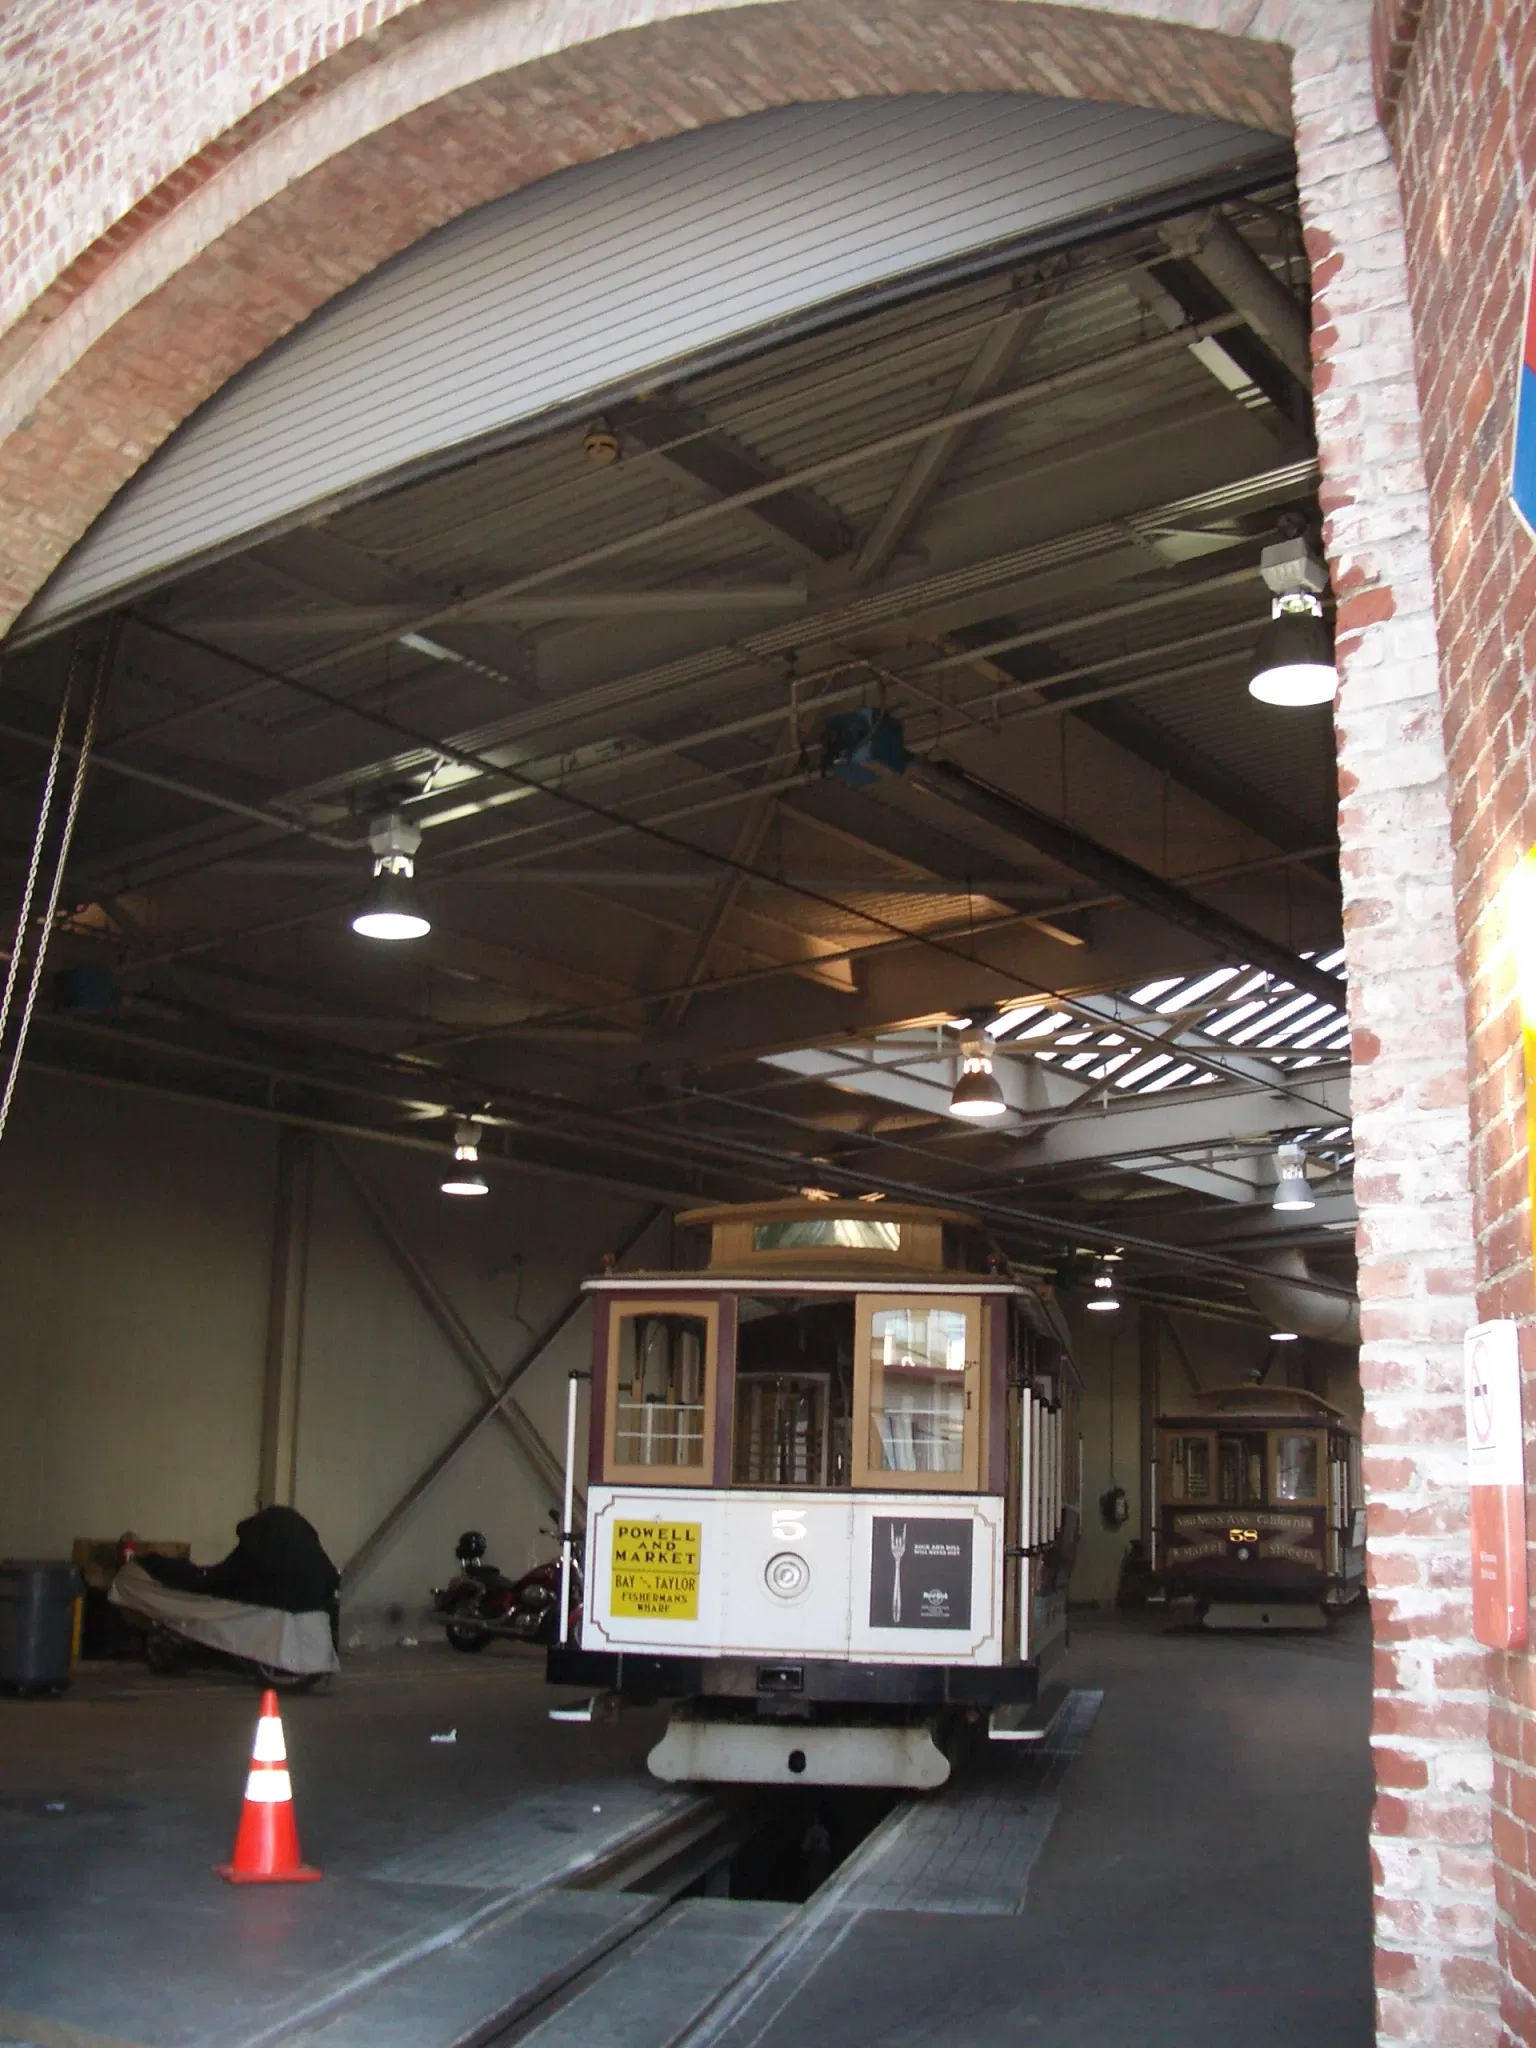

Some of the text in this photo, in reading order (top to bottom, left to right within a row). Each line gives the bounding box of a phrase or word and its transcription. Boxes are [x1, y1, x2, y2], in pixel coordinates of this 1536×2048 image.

[771, 1509, 807, 1541] 5
[1257, 1514, 1313, 1528] California
[618, 1526, 696, 1542] POWELL
[1229, 1528, 1258, 1542] 58
[638, 1541, 676, 1551] AND
[615, 1550, 696, 1565] MARKET
[615, 1575, 635, 1589] BAY
[655, 1576, 696, 1591] TAYLOR
[622, 1592, 688, 1604] FISHERMANS
[637, 1603, 670, 1613] WHARF
